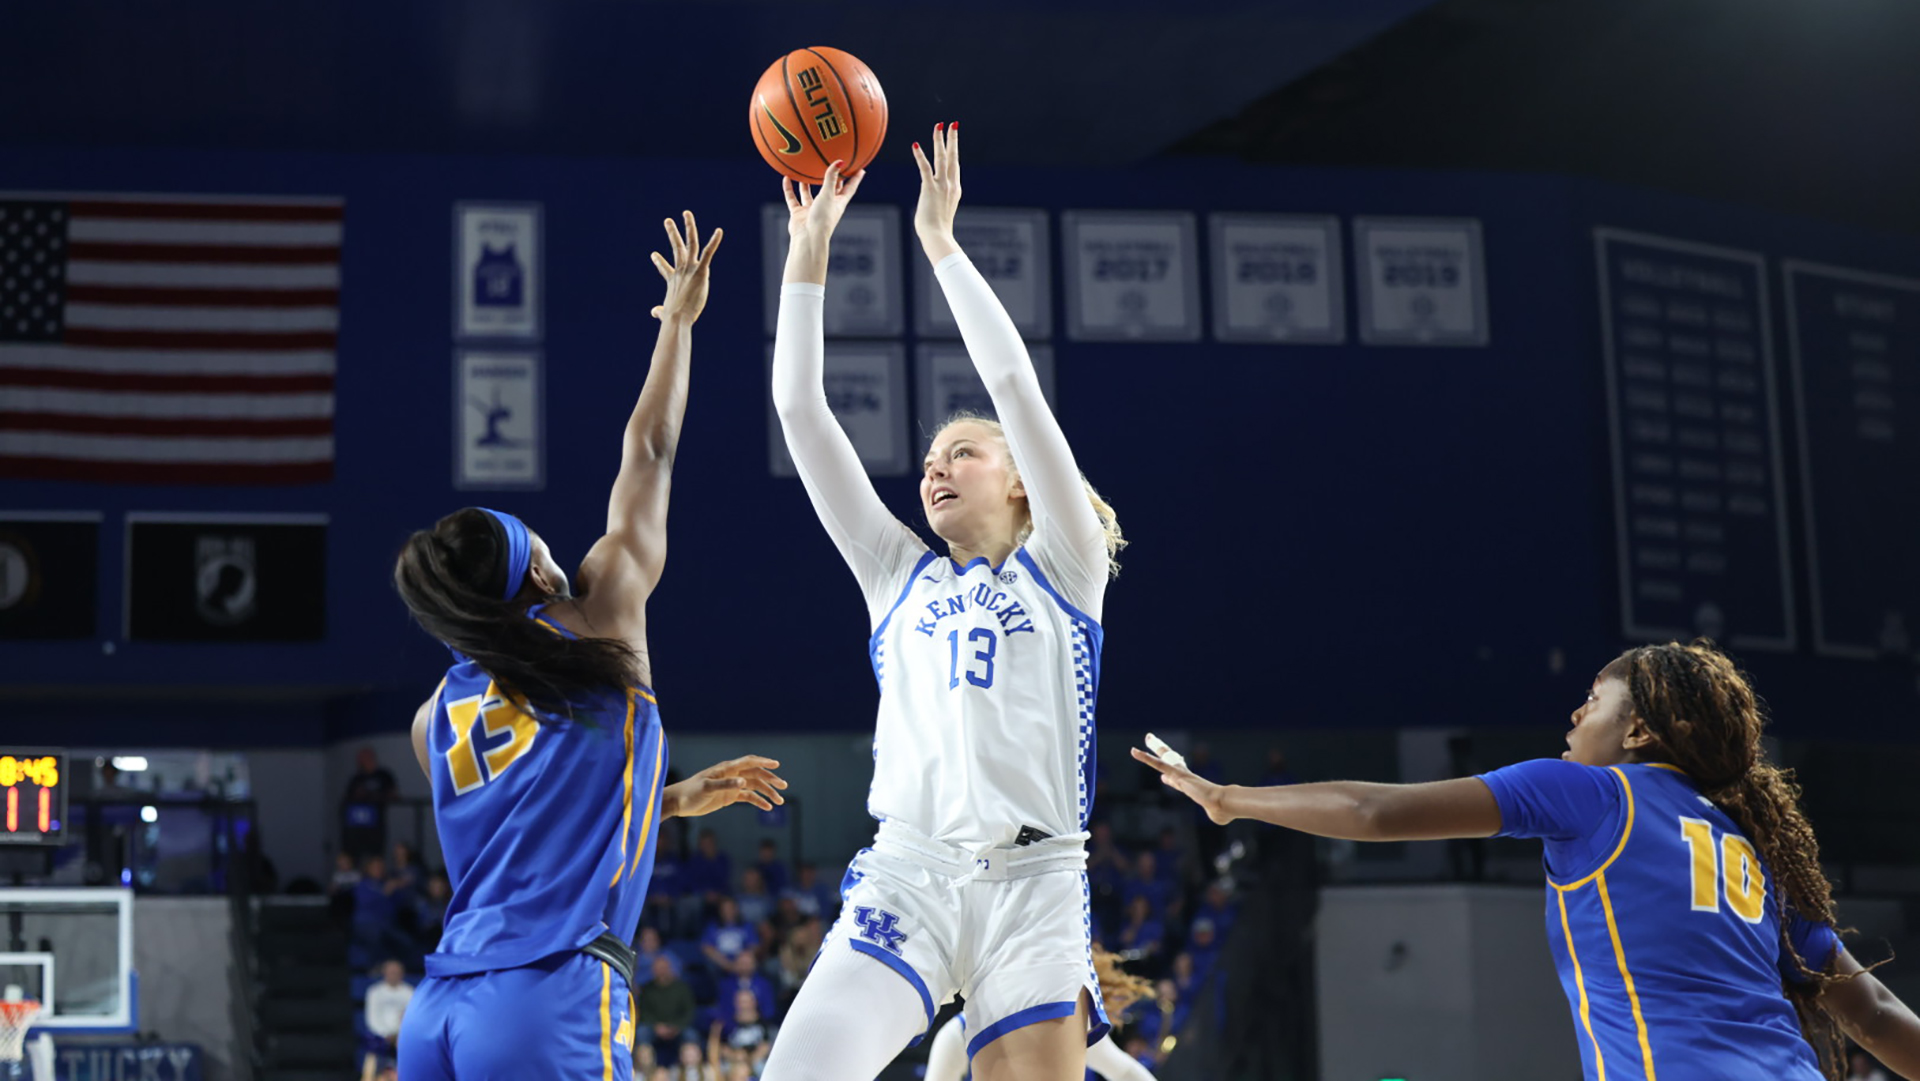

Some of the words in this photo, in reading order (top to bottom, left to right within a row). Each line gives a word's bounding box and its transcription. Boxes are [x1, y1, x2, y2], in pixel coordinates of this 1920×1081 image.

[796, 66, 842, 141] ELITE
[915, 582, 1035, 638] KENTUCKY
[947, 627, 997, 692] 13
[446, 676, 541, 798] 13
[1679, 816, 1767, 924] 10
[853, 905, 908, 957] UK
[61, 1047, 194, 1081] TUCKY
